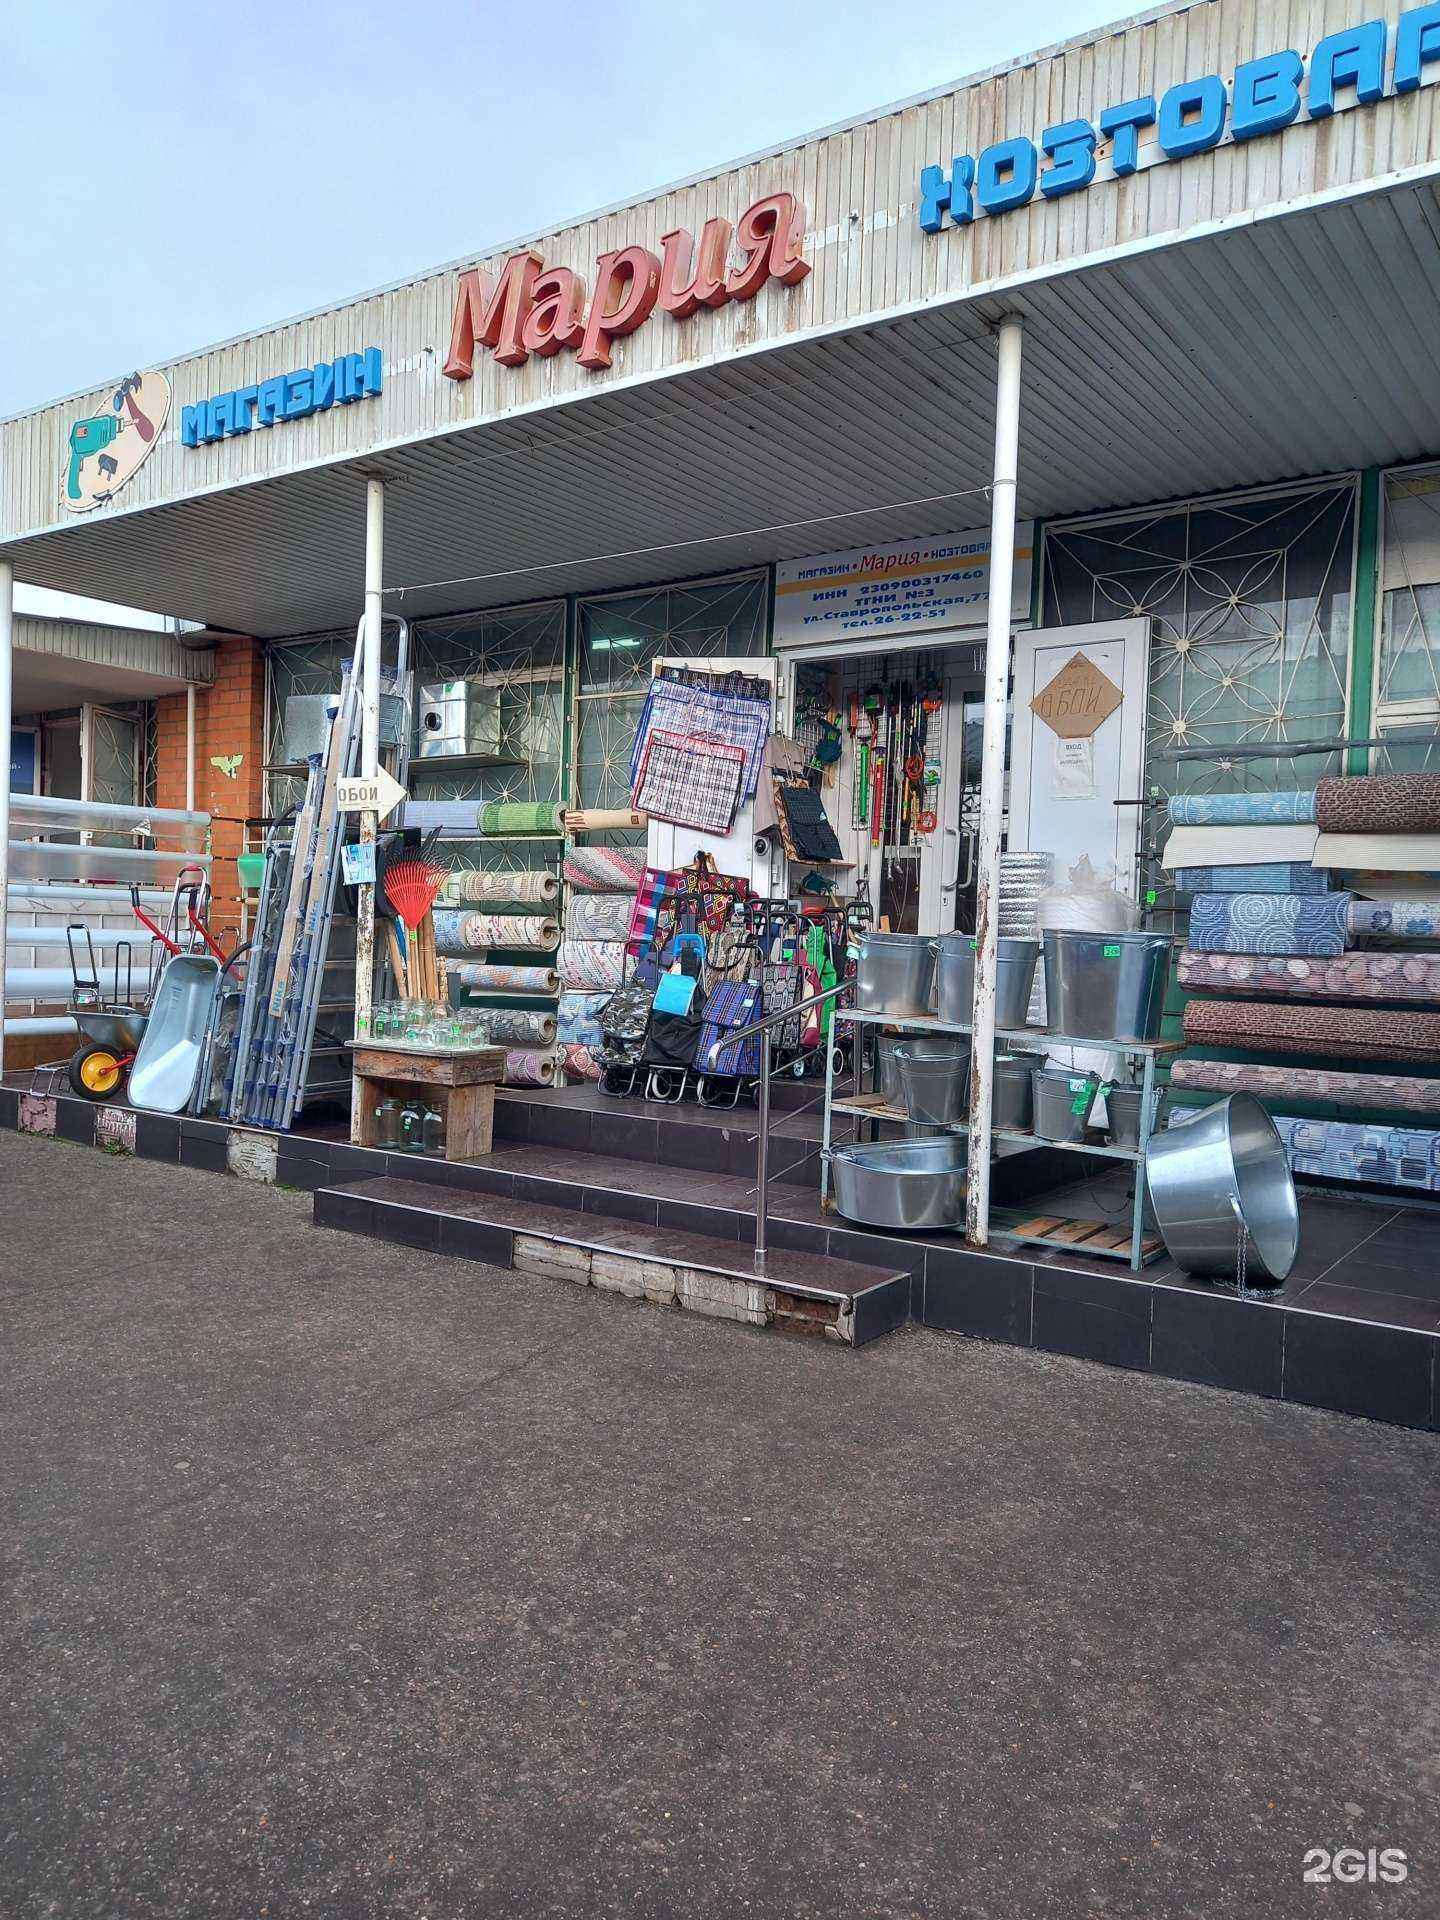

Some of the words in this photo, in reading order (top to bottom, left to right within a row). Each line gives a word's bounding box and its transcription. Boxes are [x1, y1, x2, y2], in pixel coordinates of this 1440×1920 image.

[442, 192, 811, 381] Мария
[181, 346, 383, 448] МАГАЗИН
[798, 563, 850, 580] МАГАЗИН
[859, 551, 921, 573] Мария
[812, 589, 848, 601] ИНН
[905, 589, 935, 600] №3
[338, 787, 378, 801] ОБОИ
